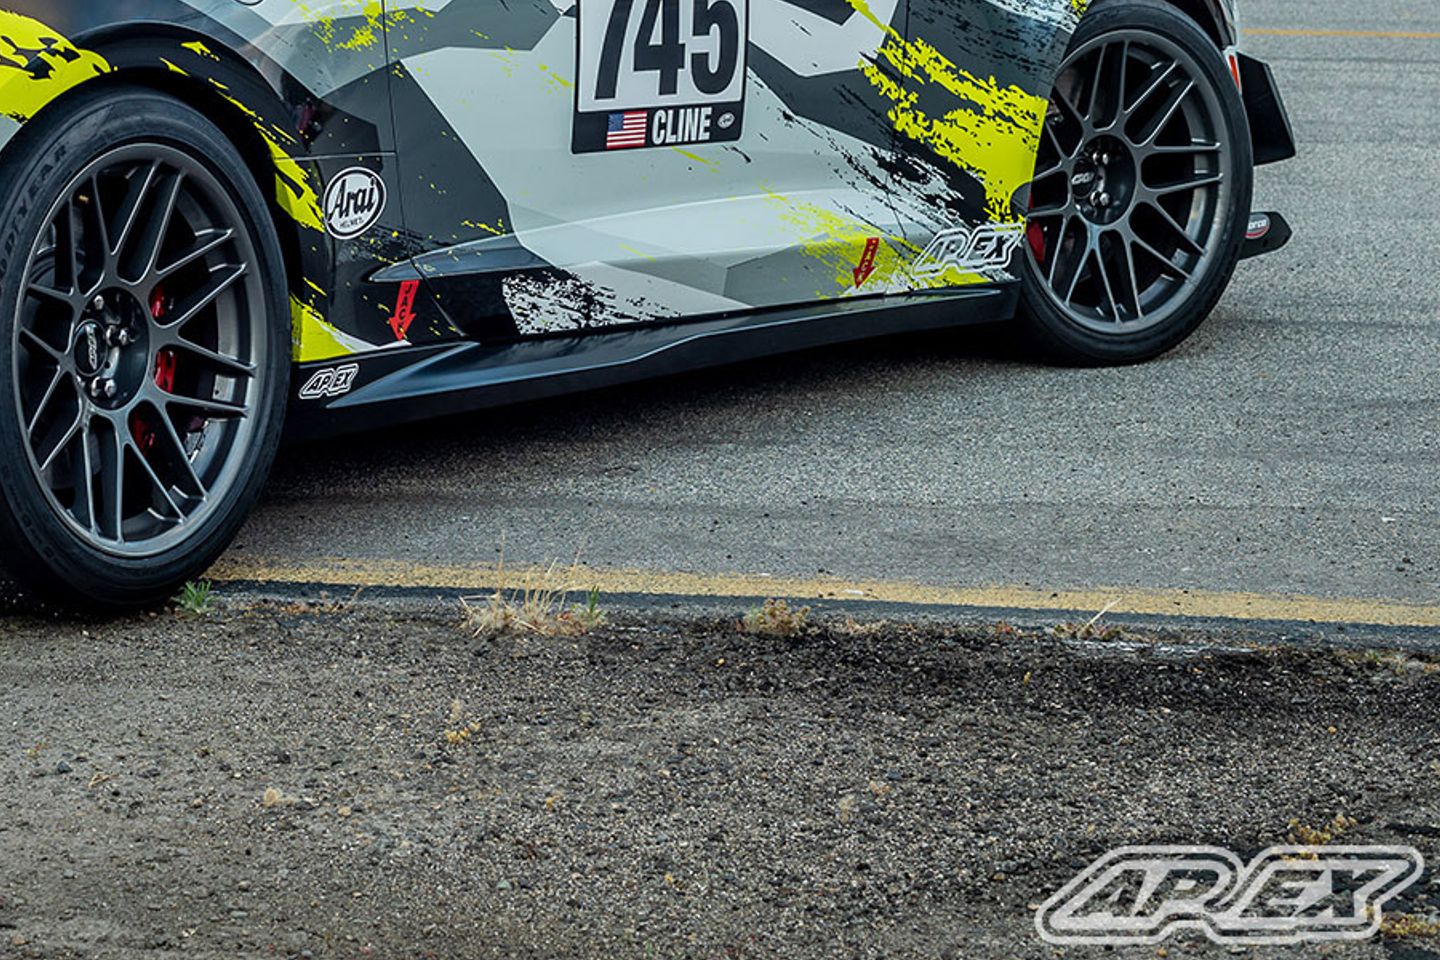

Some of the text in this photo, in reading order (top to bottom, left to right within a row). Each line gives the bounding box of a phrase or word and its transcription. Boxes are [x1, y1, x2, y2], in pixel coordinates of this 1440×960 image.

[652, 106, 712, 145] CLINE
[327, 177, 376, 221] Arai
[299, 364, 358, 398] APEX
